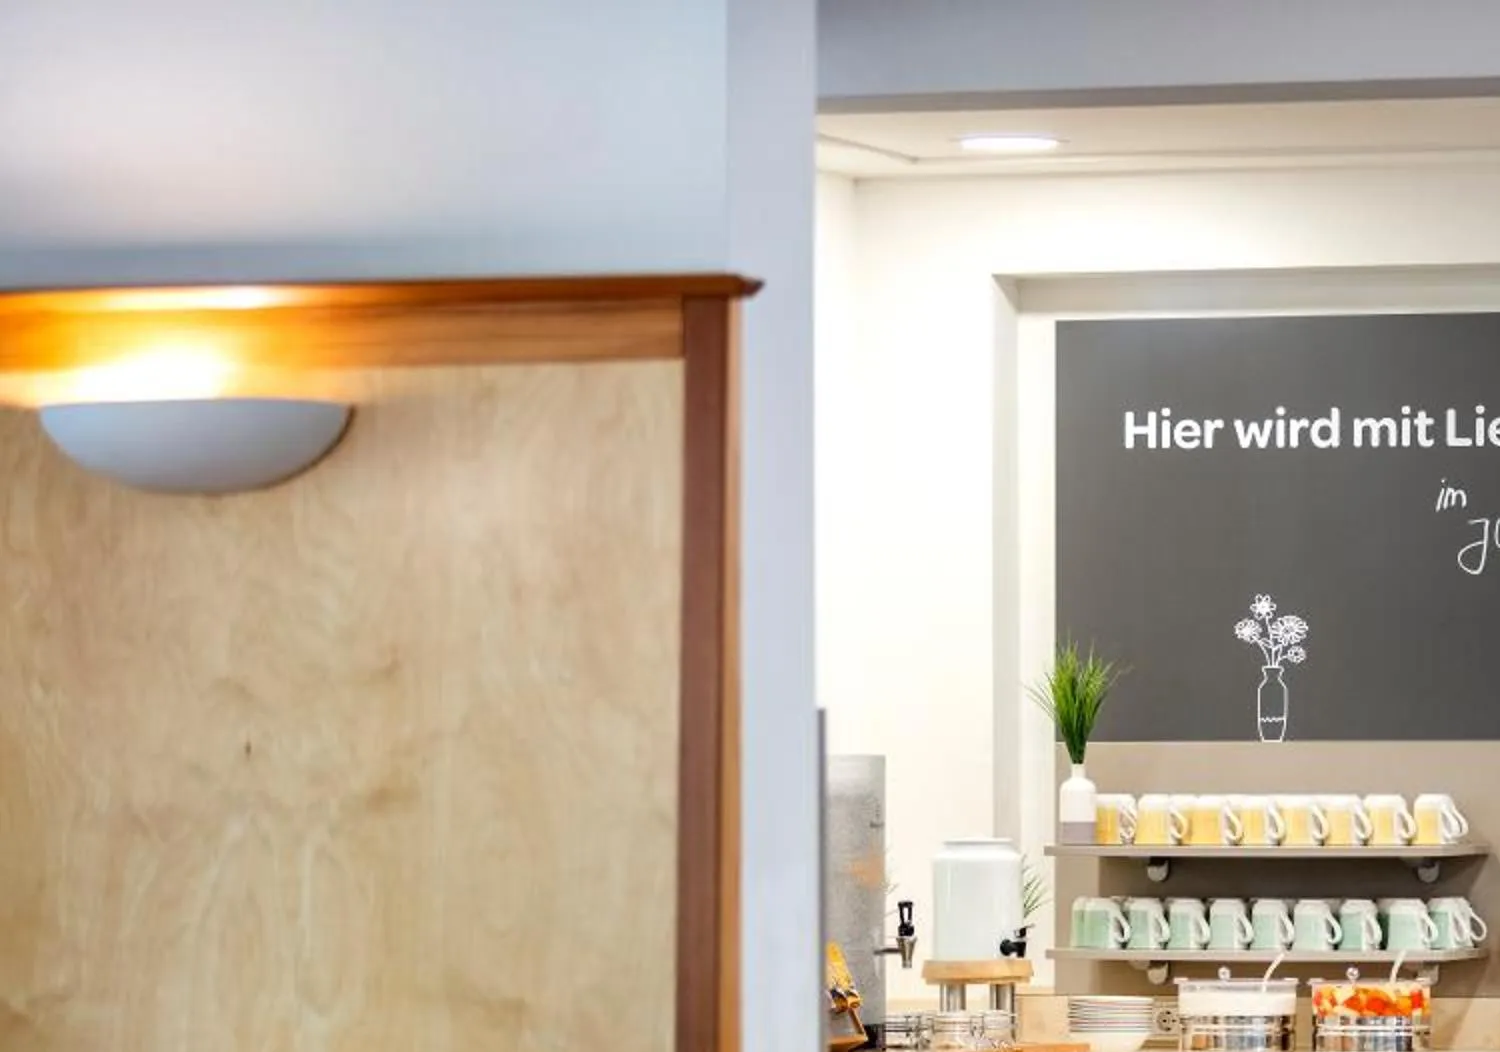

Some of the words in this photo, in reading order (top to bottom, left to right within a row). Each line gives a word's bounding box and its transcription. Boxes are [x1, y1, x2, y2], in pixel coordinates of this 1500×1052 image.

[1122, 406, 1225, 451] Hier
[1232, 405, 1342, 450] wird
[1352, 404, 1435, 449] mit
[1435, 478, 1468, 512] im
